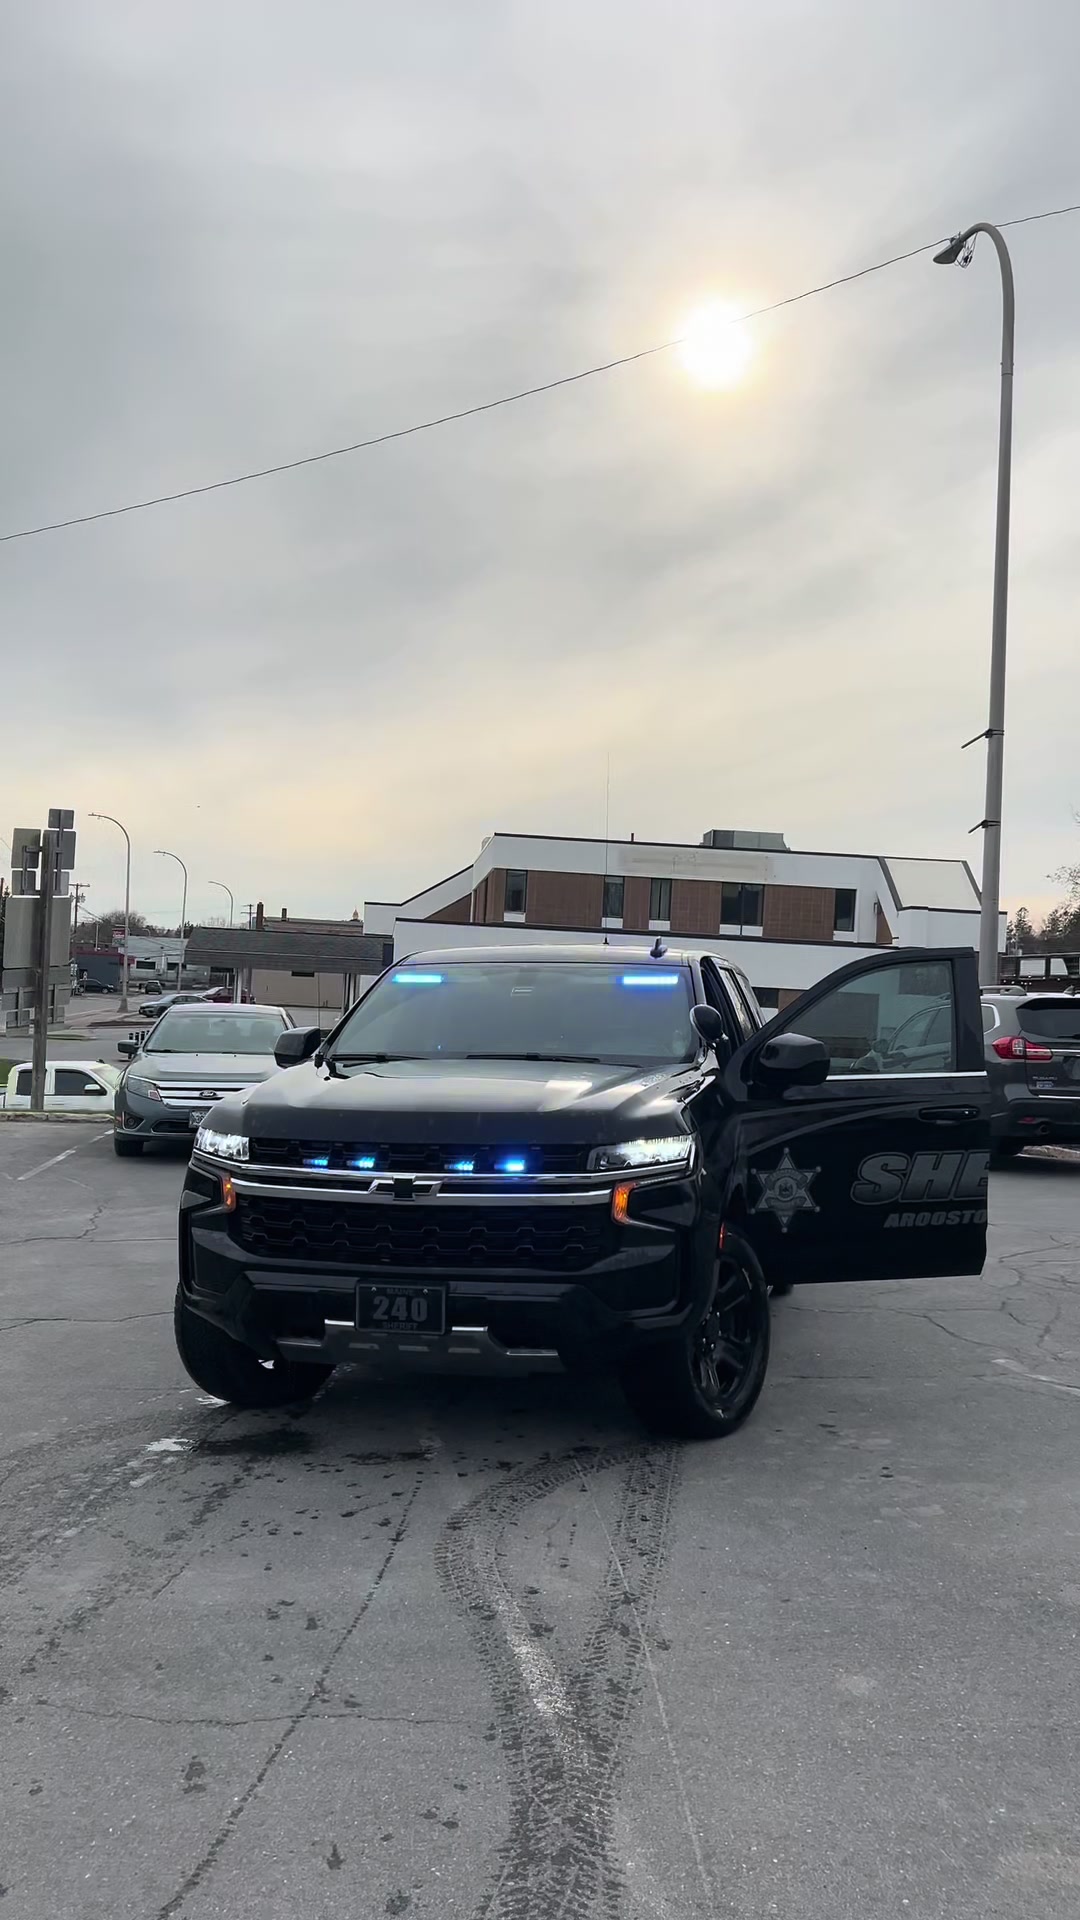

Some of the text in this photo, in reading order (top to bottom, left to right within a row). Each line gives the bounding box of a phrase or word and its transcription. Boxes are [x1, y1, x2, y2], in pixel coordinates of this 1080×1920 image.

[883, 1209, 987, 1228] AROOSTO
[372, 1295, 428, 1322] 240
[382, 1321, 418, 1330] SHERIFF
